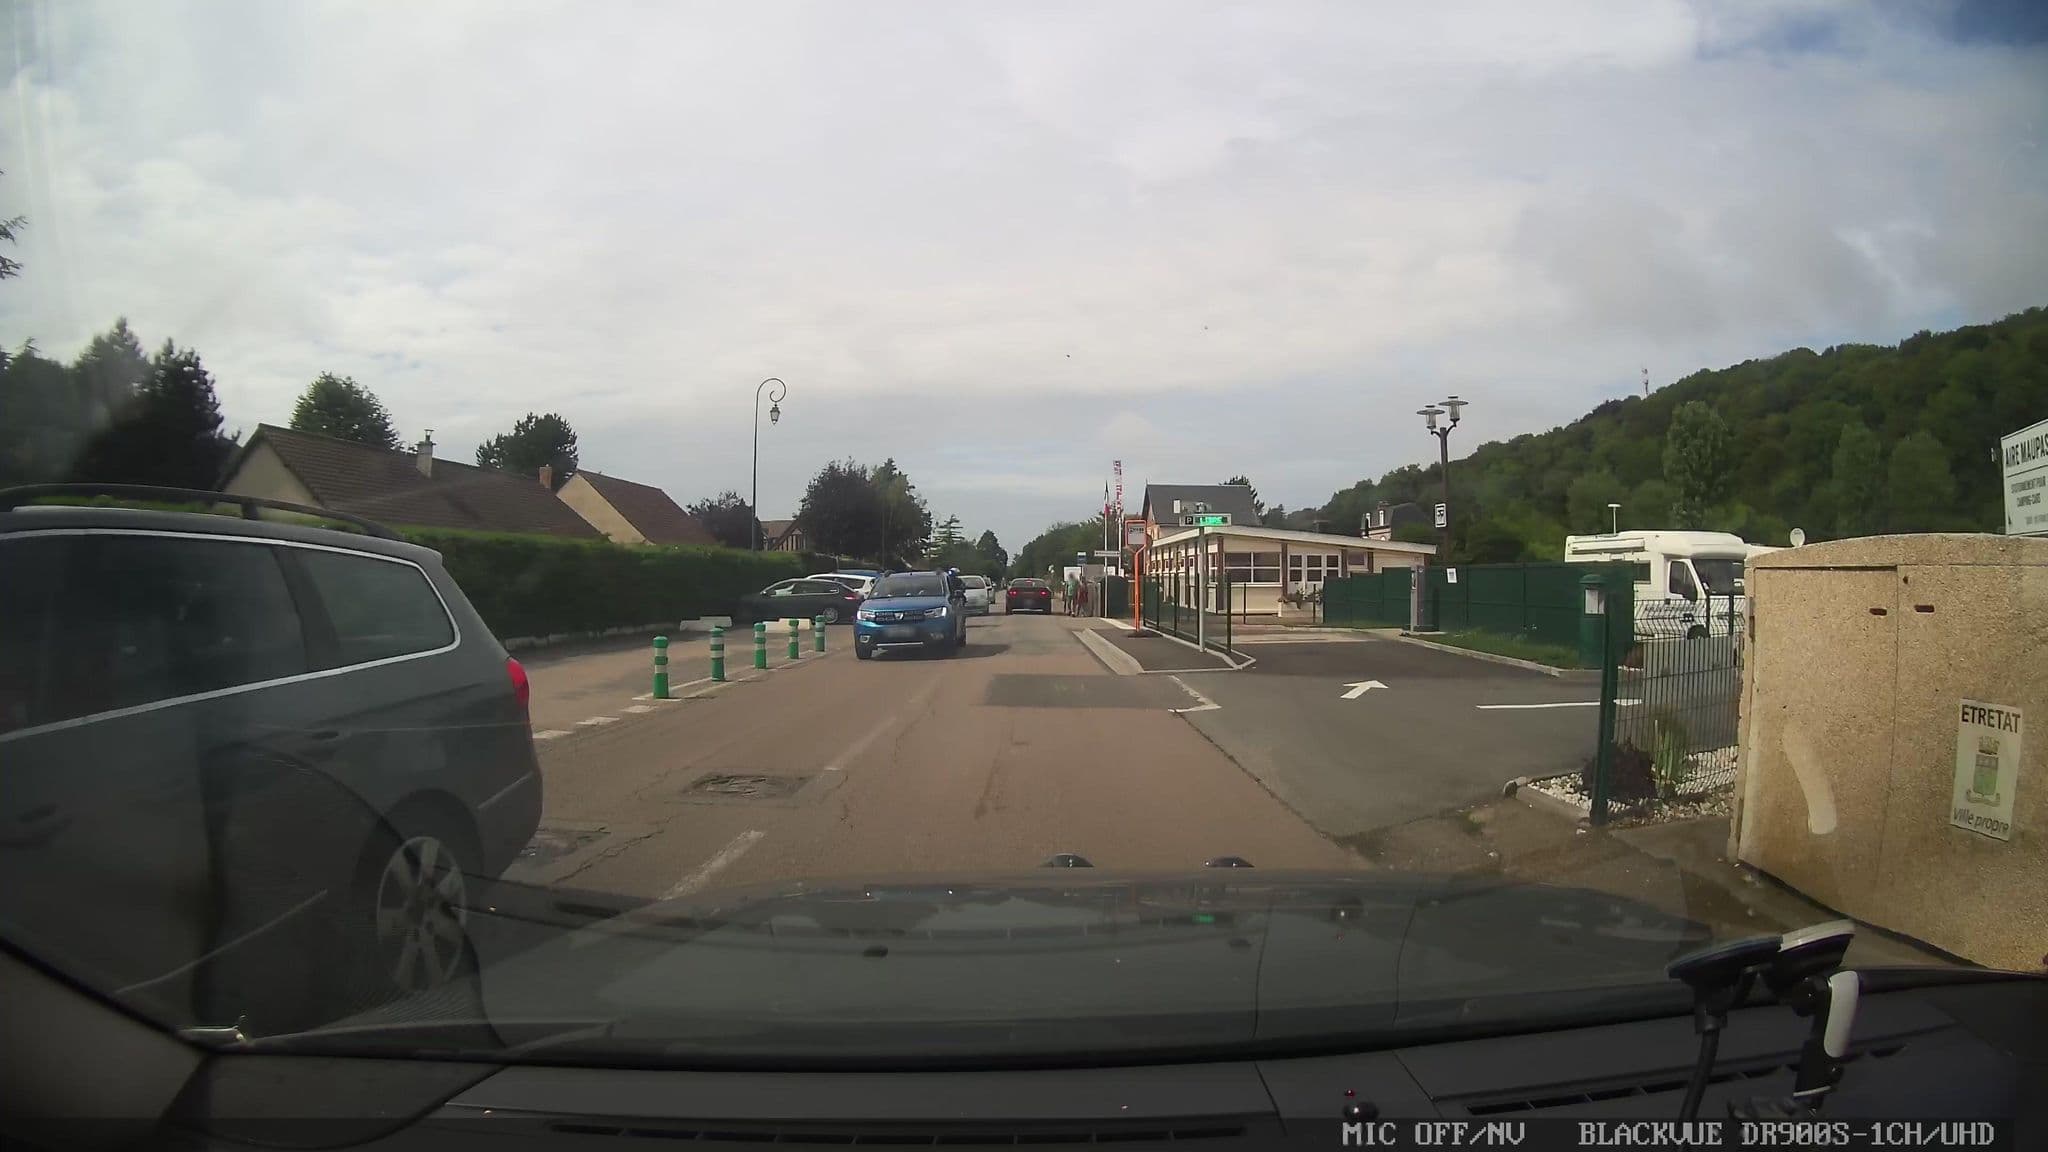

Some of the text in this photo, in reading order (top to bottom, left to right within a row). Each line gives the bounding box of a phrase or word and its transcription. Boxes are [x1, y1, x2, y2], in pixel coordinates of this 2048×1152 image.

[2006, 443, 2020, 467] AIRE
[1961, 704, 2021, 734] ETRETAT
[1974, 815, 2009, 835] propre
